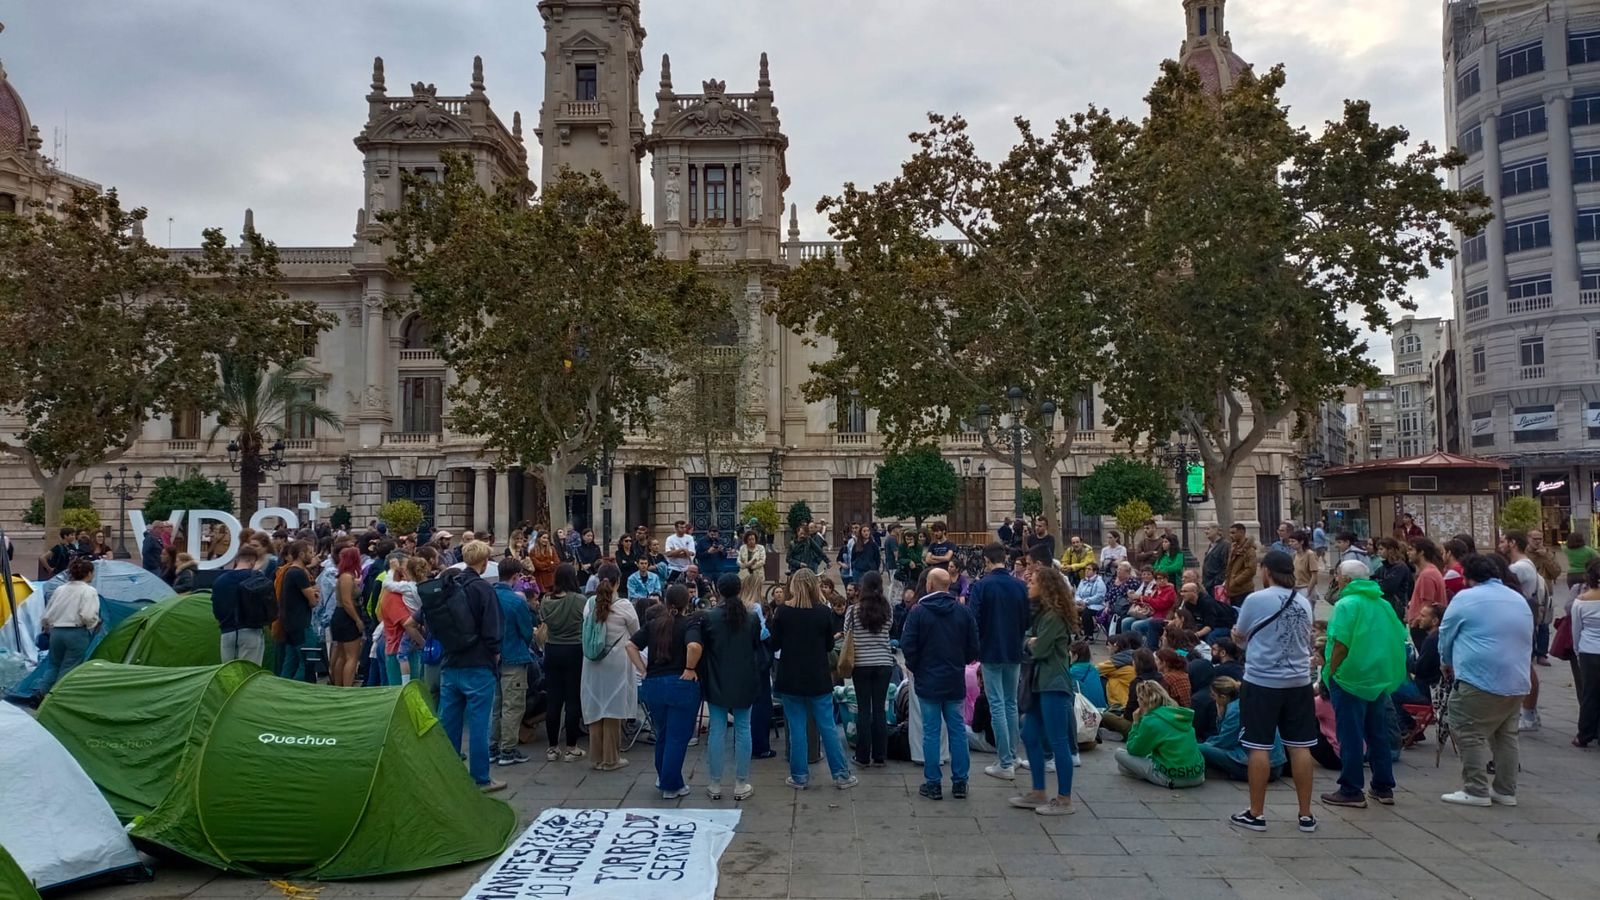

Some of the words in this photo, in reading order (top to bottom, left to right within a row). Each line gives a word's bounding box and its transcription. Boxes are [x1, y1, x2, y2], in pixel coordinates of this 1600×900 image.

[258, 733, 336, 745] Quechua
[593, 830, 659, 884] TORRES
[646, 821, 697, 881] SERRANS
[525, 884, 571, 898] 19
